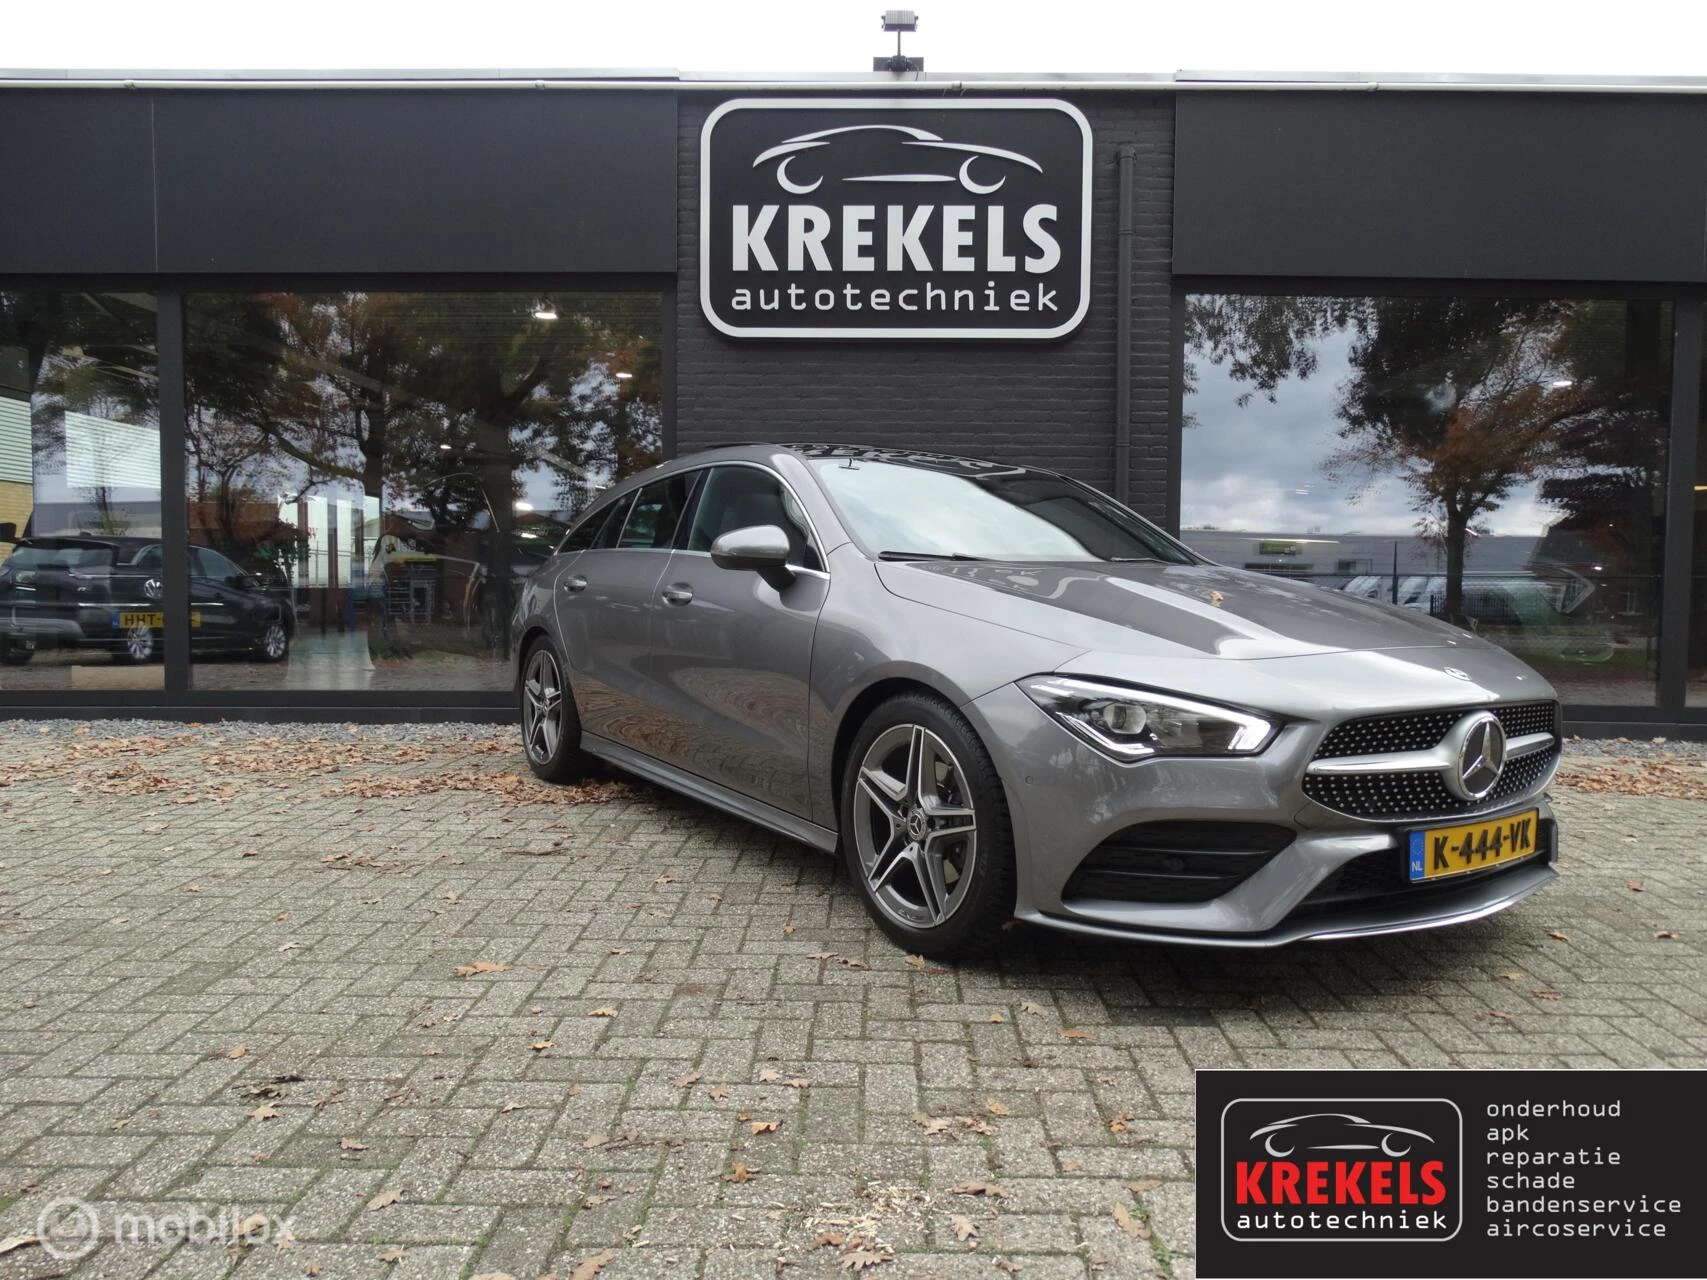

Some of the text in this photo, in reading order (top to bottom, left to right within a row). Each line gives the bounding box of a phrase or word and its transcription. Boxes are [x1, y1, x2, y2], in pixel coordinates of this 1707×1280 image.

[732, 203, 1062, 274] KREKELS
[731, 280, 1059, 312] autotechniek
[1411, 818, 1532, 872] NL K-444-VK
